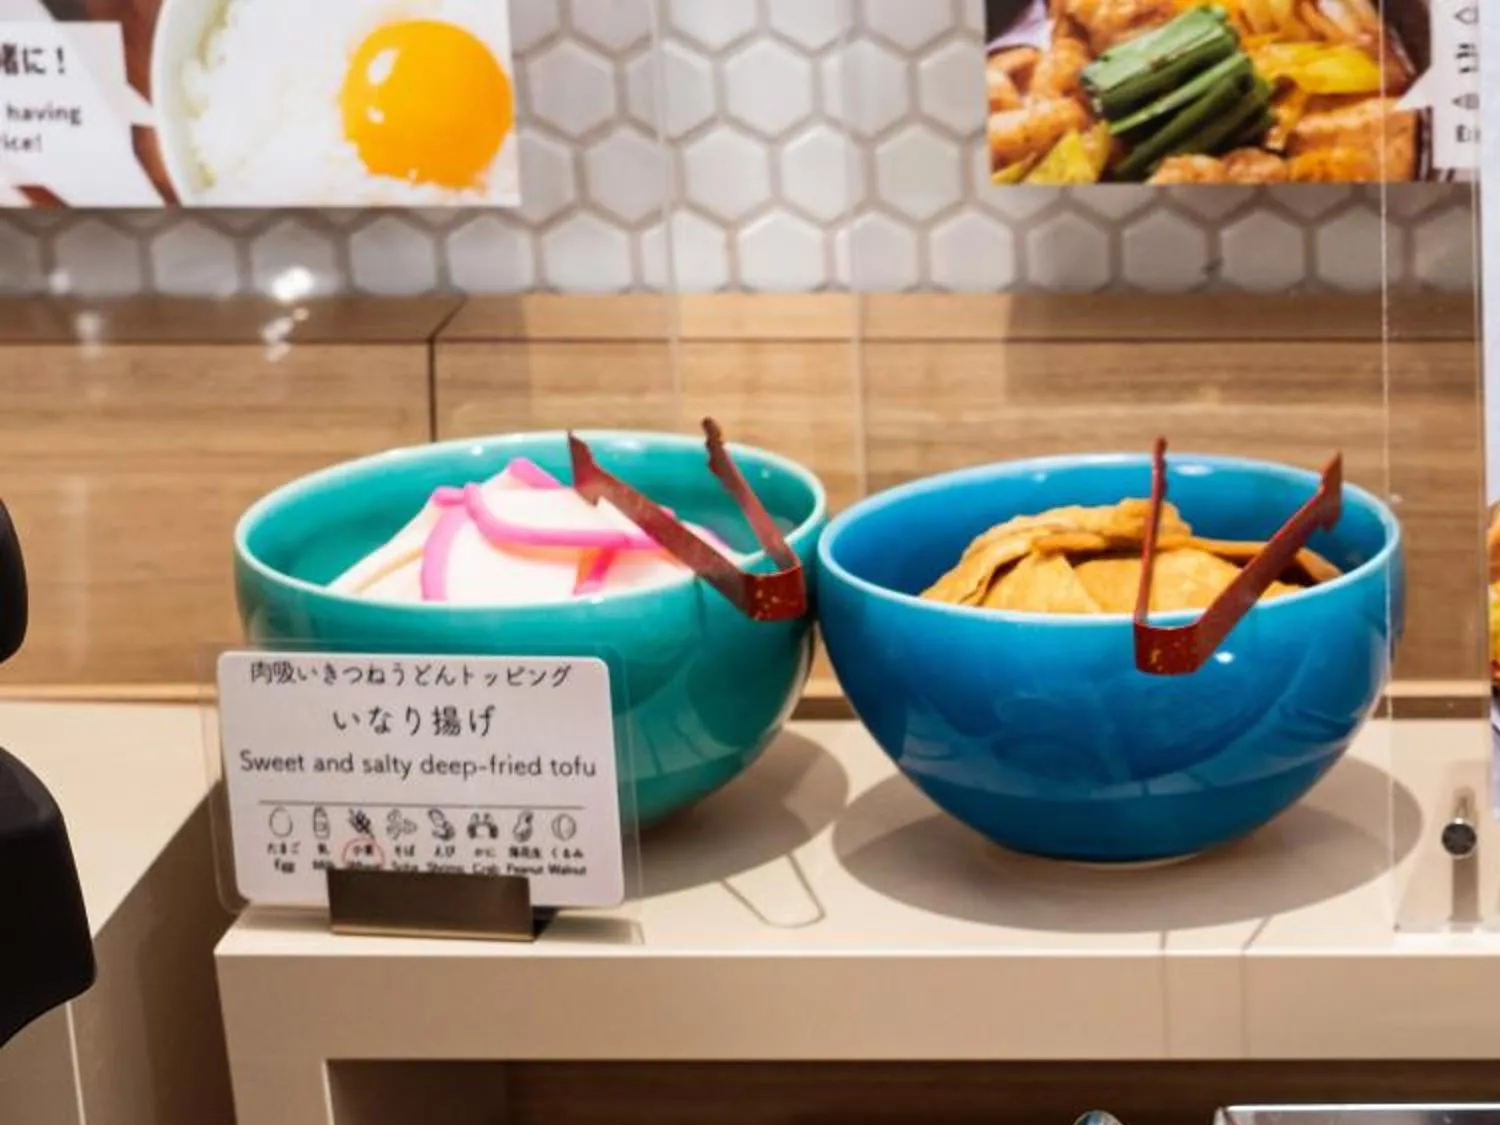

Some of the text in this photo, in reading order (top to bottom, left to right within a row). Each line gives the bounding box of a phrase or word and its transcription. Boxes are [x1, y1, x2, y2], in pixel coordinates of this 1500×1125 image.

[6, 101, 82, 127] having
[0, 132, 43, 154] ice!
[333, 704, 497, 738] いなり揚げ
[240, 749, 597, 782] Sweet and salty deep-fried tofu
